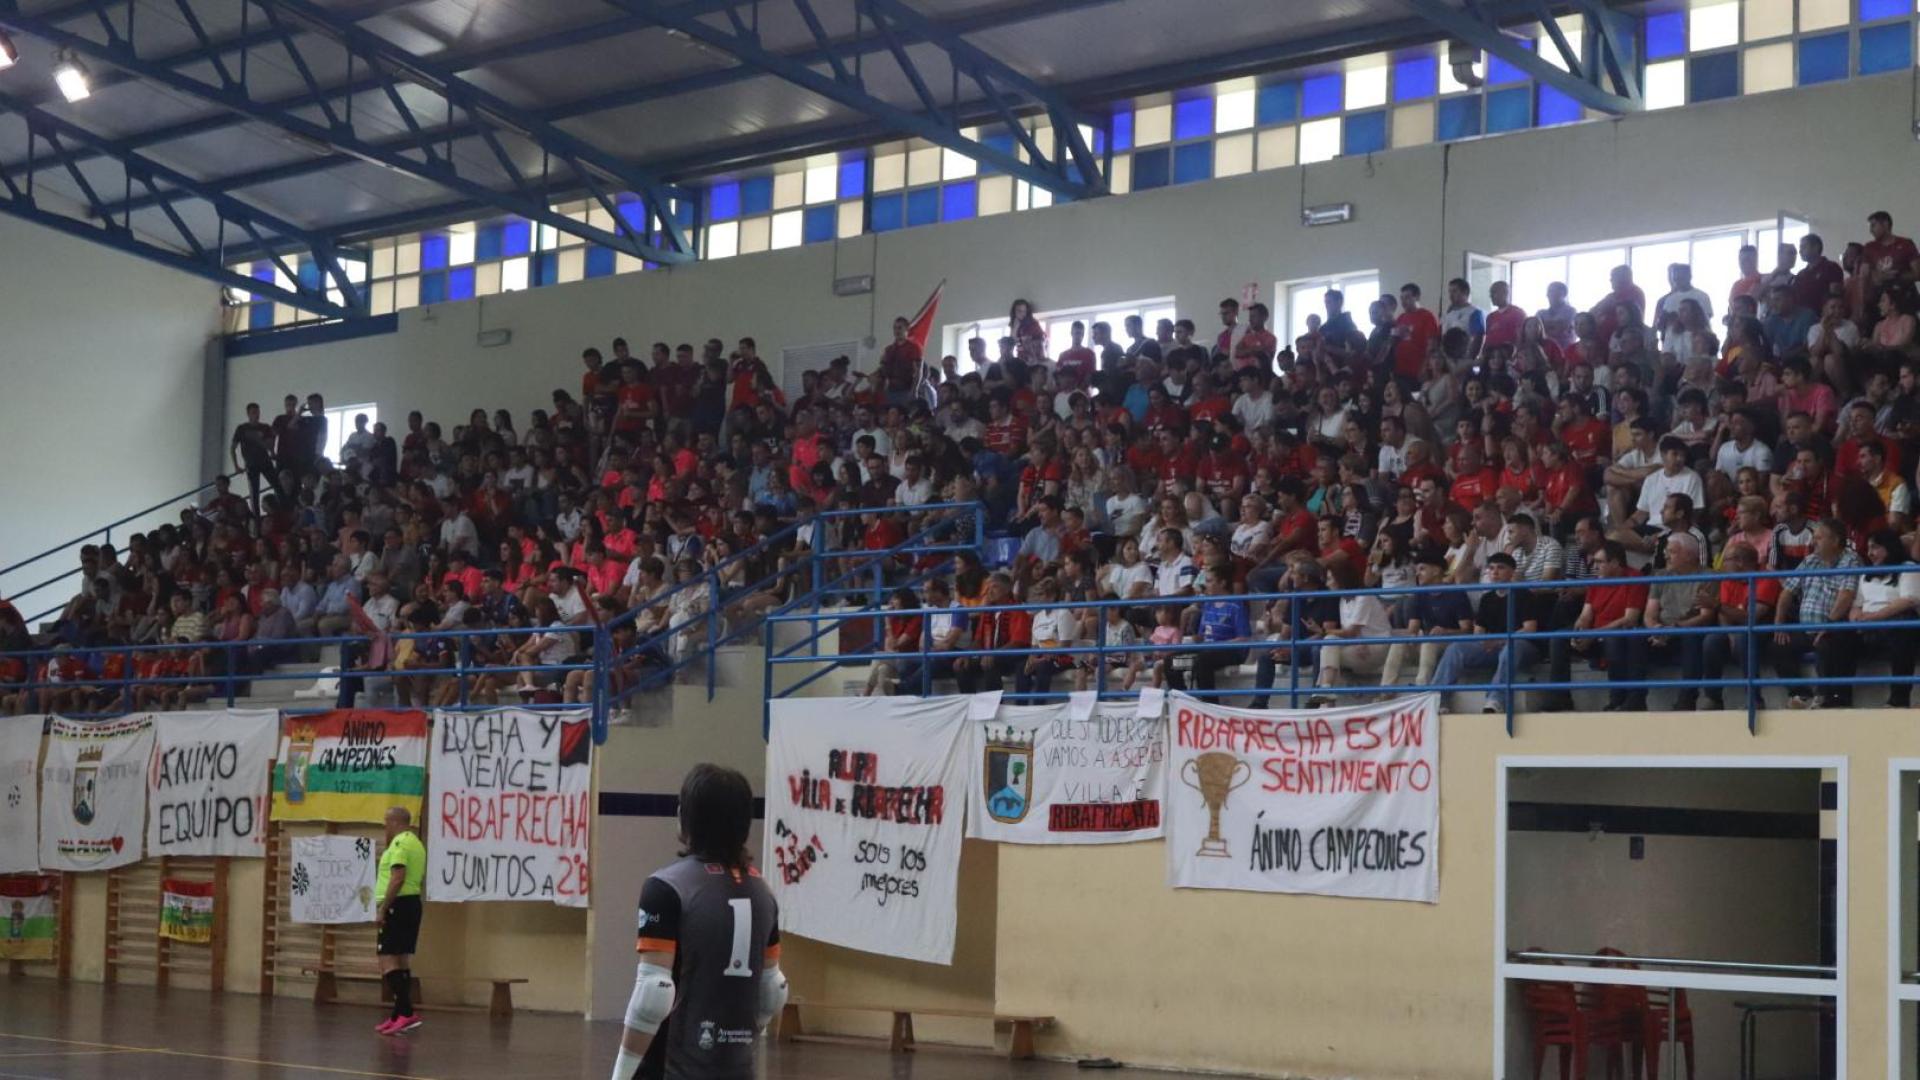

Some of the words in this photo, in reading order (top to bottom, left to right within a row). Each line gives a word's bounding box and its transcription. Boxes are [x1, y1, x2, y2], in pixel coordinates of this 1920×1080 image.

[442, 712, 524, 756] LUCHA
[540, 715, 559, 749] Y
[1178, 709, 1334, 756] RIBAFRECHA
[1345, 716, 1381, 750] ES
[1389, 709, 1423, 748] UN
[319, 745, 396, 773] CAMPEONES
[461, 754, 552, 792] VENCE
[1043, 746, 1088, 768] VAMOS
[1095, 749, 1105, 768] A
[789, 769, 831, 811] VILLA
[442, 789, 588, 849] RIBAFRECHA
[1310, 826, 1427, 874] CAMPEONES
[443, 850, 536, 897] JUNTOS
[542, 874, 554, 896] A
[723, 898, 753, 978] 1
